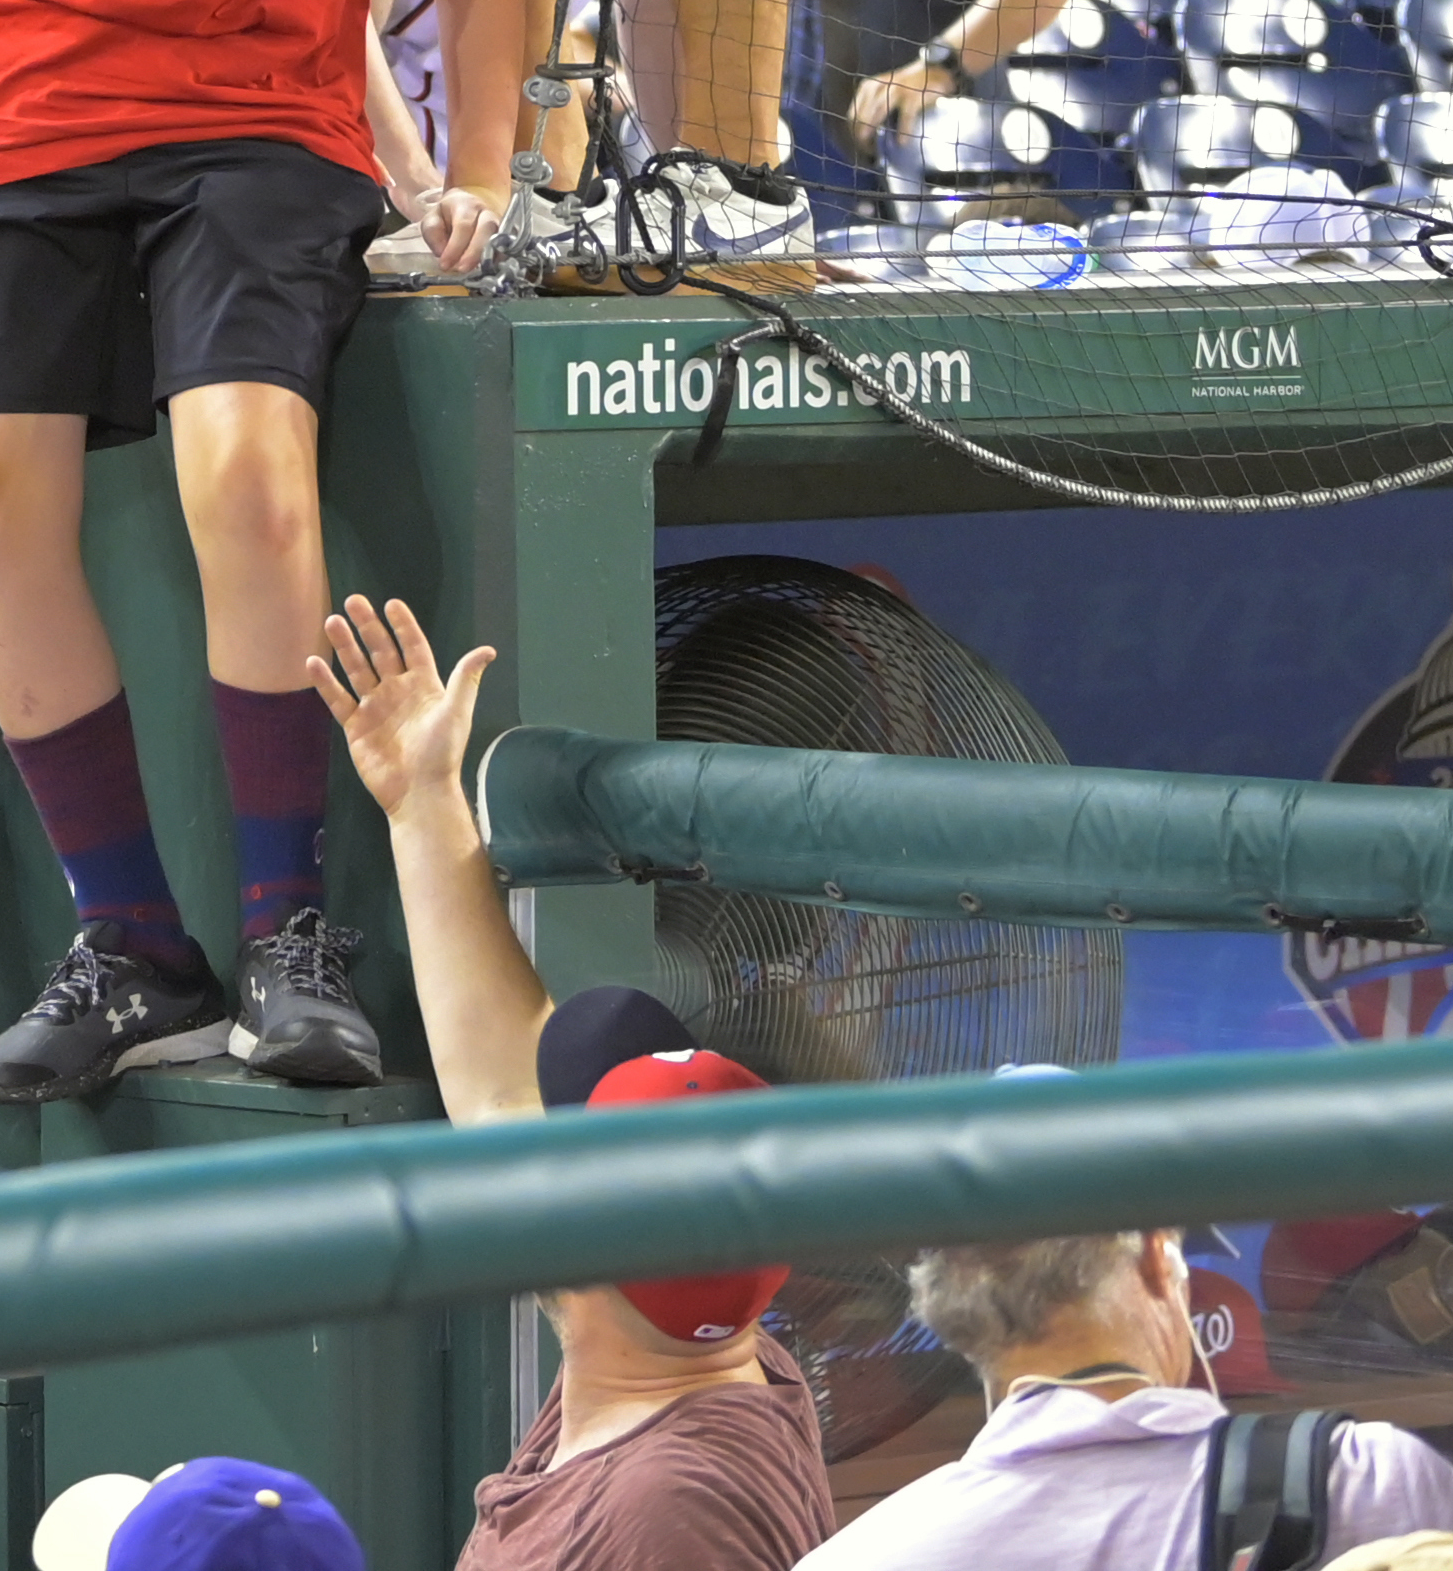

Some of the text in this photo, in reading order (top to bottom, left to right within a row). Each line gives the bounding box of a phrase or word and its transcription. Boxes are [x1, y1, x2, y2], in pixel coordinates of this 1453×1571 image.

[1192, 324, 1302, 370] MGM
[566, 337, 972, 417] nationals.com
[1191, 385, 1250, 398] NATIONAL
